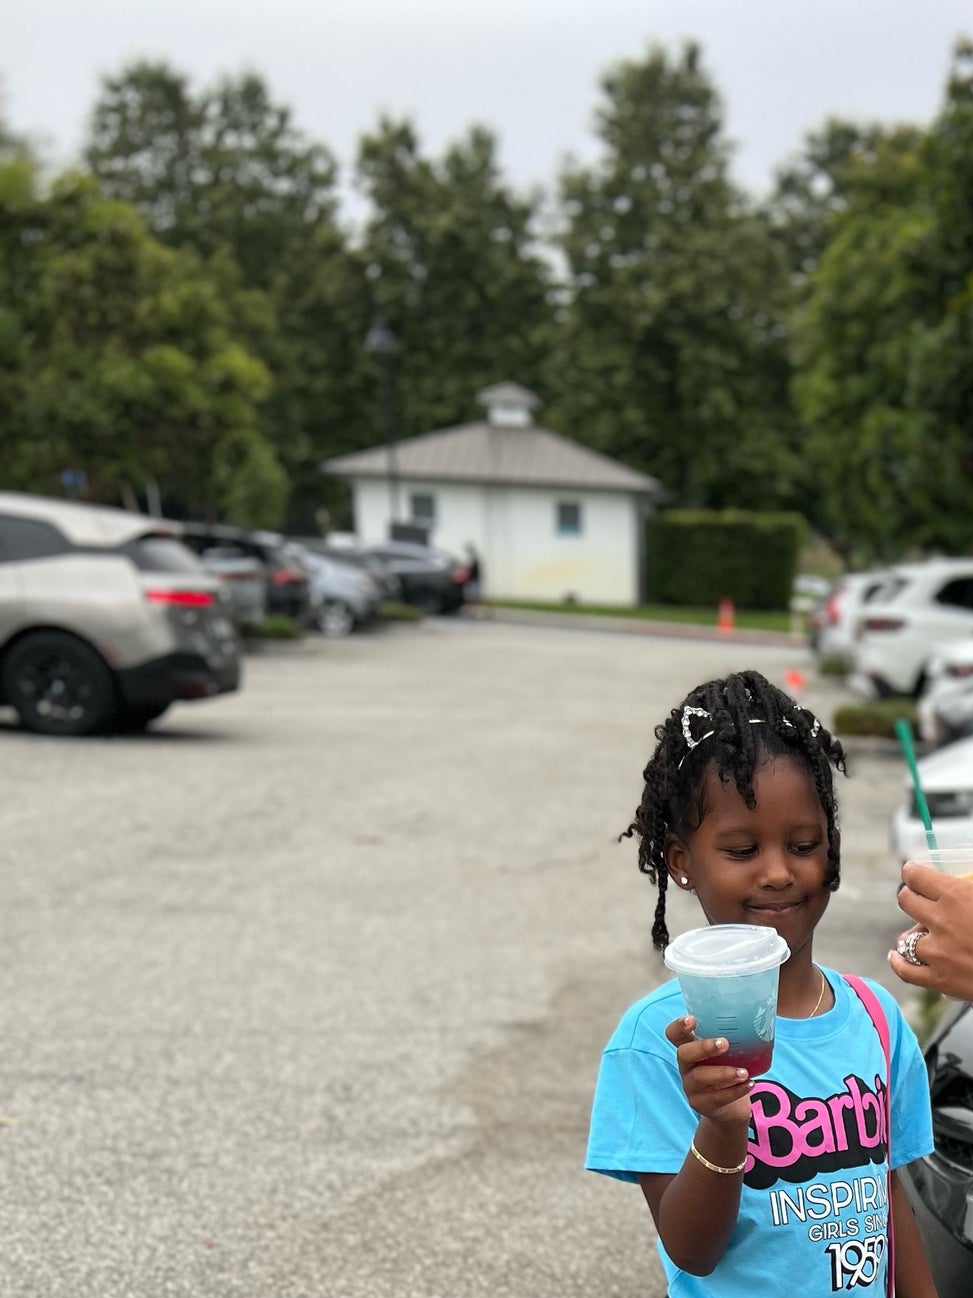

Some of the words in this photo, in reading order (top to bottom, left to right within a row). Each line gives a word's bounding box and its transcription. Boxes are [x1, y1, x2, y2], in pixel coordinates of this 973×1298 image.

[744, 1075, 887, 1175] Barbi
[769, 1174, 887, 1226] INSPIRIN
[808, 1218, 859, 1242] GIRLS
[825, 1234, 885, 1291] 1959
